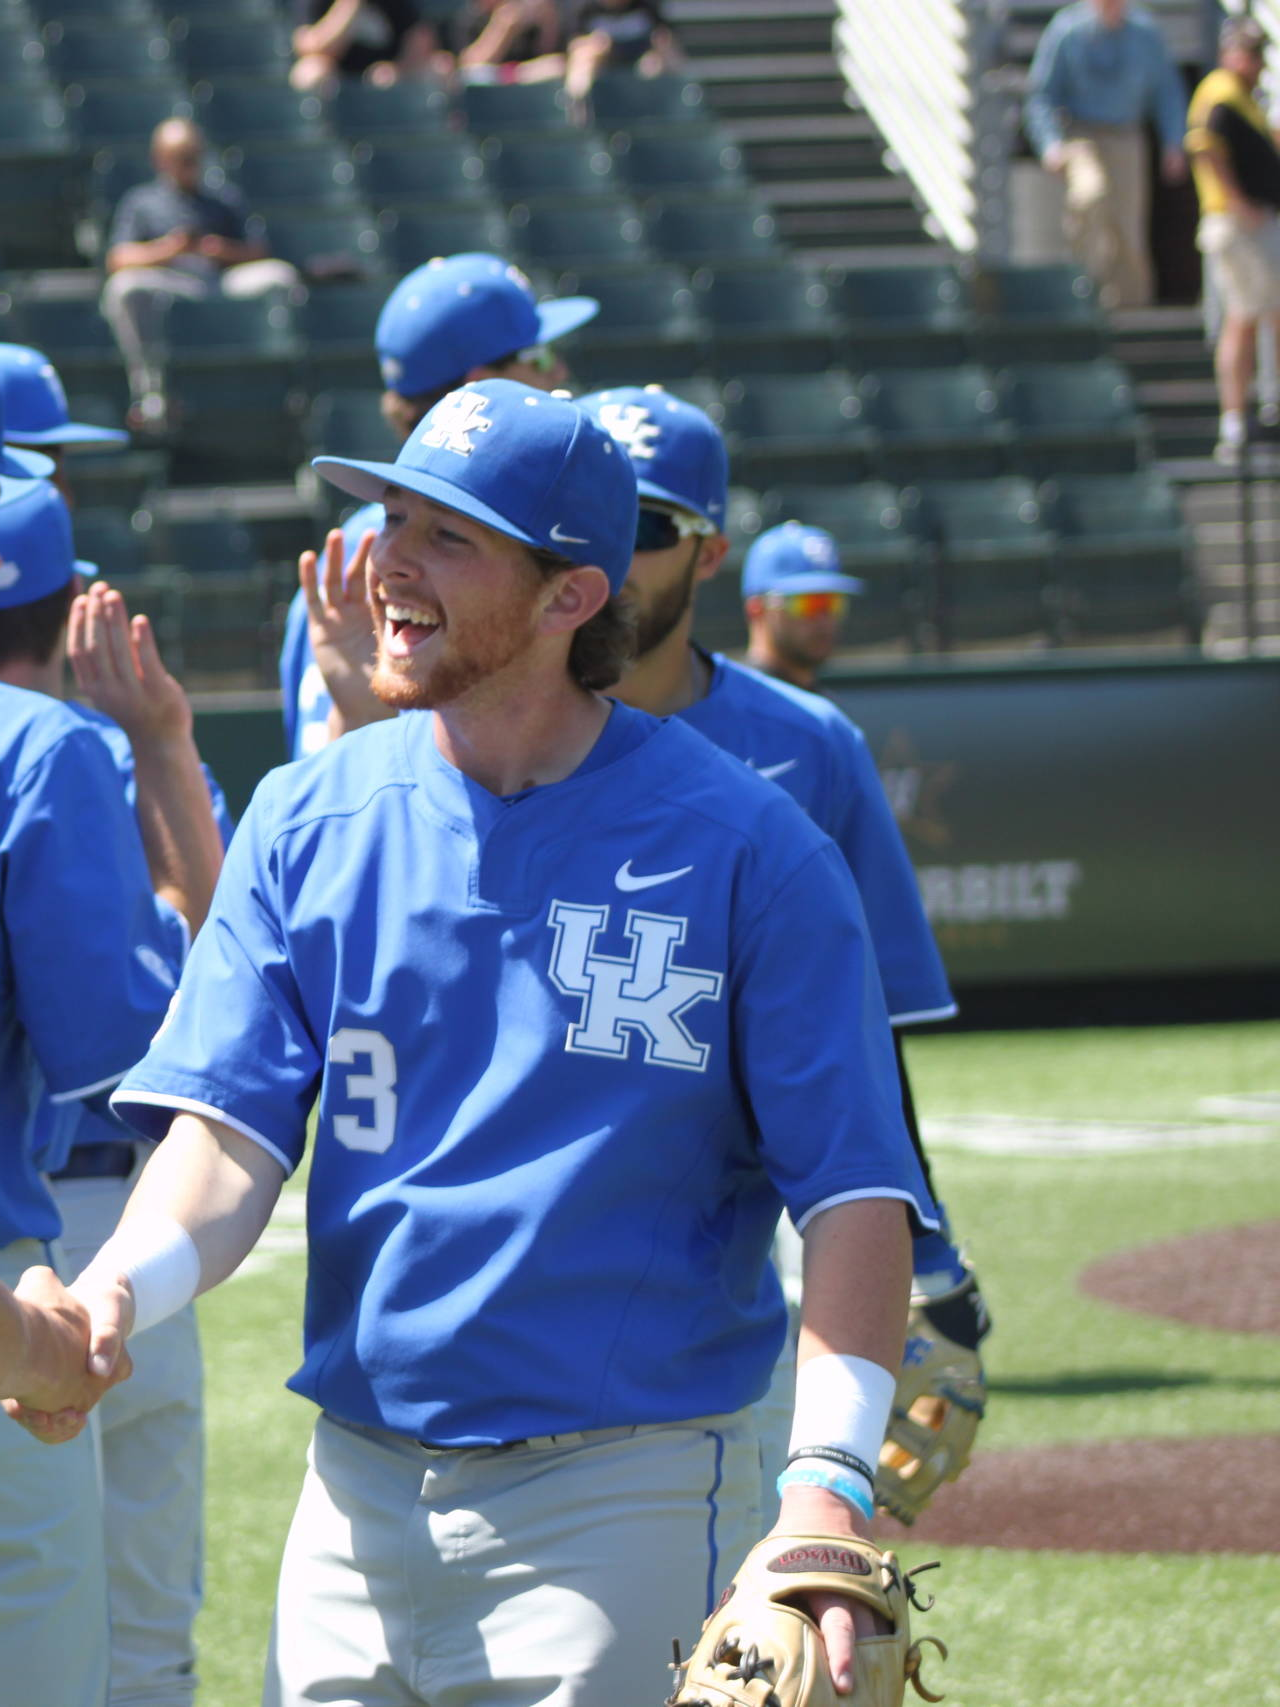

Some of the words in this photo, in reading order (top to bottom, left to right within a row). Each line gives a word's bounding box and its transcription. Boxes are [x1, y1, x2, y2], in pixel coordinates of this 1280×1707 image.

[547, 899, 724, 1073] UK
[328, 1027, 398, 1155] 3
[778, 1548, 864, 1571] Wilson
